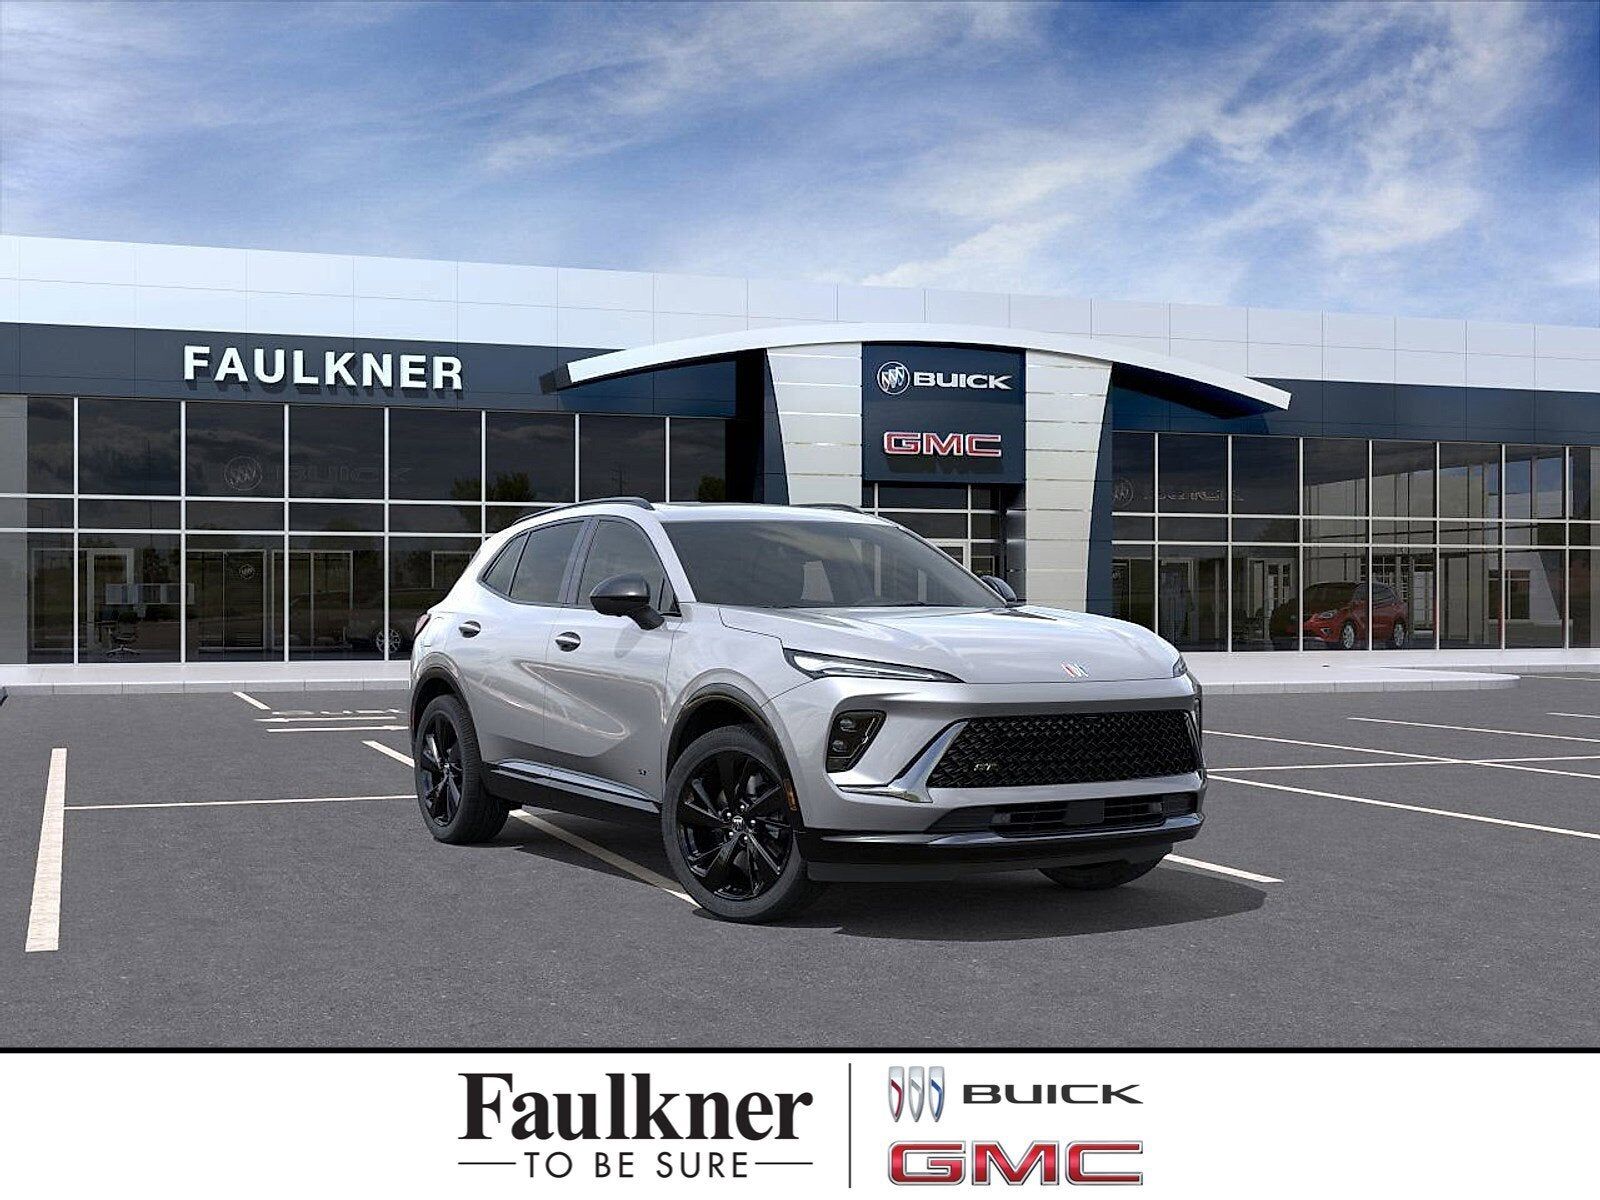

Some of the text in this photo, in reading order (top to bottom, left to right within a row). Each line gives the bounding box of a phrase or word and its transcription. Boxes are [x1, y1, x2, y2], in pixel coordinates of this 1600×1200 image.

[183, 345, 463, 390] FAULKNER
[913, 371, 1012, 390] BUICK
[884, 431, 1002, 457] GMC
